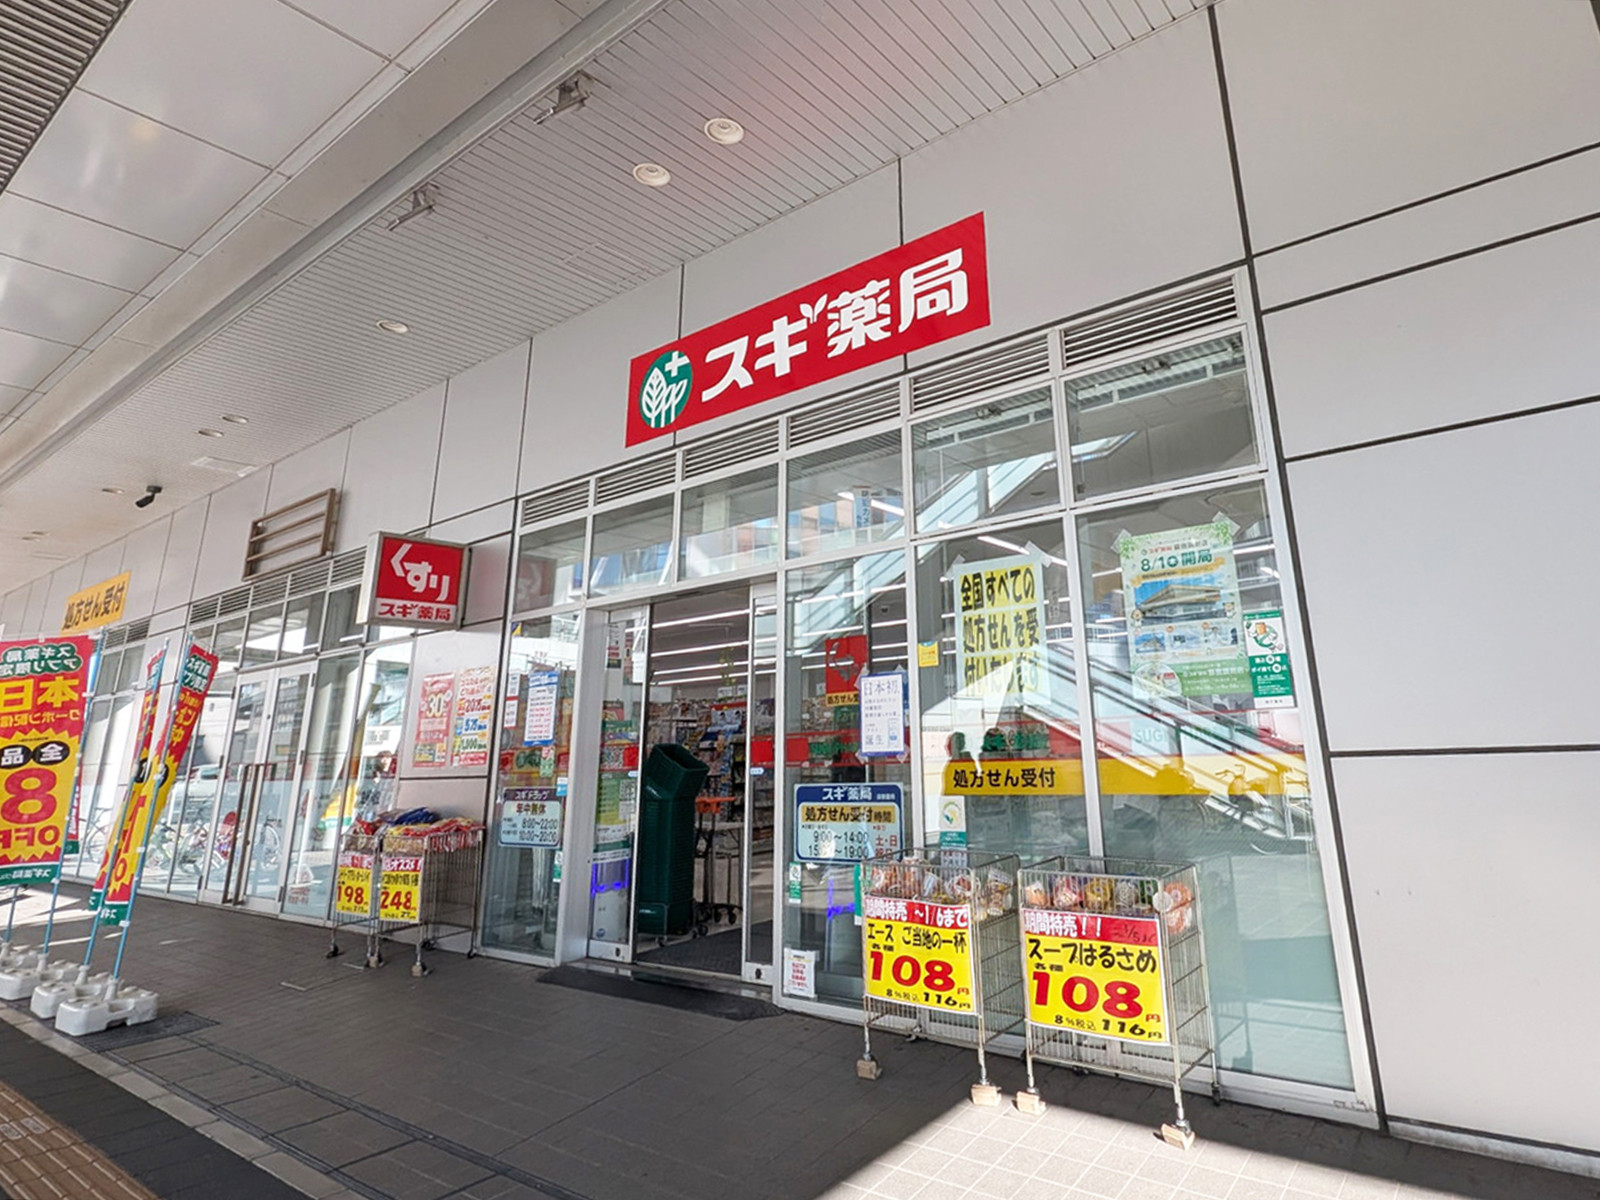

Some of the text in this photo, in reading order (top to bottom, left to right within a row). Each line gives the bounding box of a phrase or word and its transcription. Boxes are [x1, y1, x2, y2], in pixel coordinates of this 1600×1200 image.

[701, 248, 969, 403] スギ薬局
[390, 542, 450, 602] くすり
[960, 566, 1036, 612] 全国すべての
[62, 580, 126, 631] 処方せん受付
[378, 603, 451, 621] スギ薬局
[963, 607, 1040, 653] 処方せんを受
[822, 786, 872, 801] スギ薬局
[953, 767, 1055, 788] 処方せん受付
[867, 923, 968, 954] エース ご当地の一杯
[1028, 939, 1158, 974] スープはるさめ
